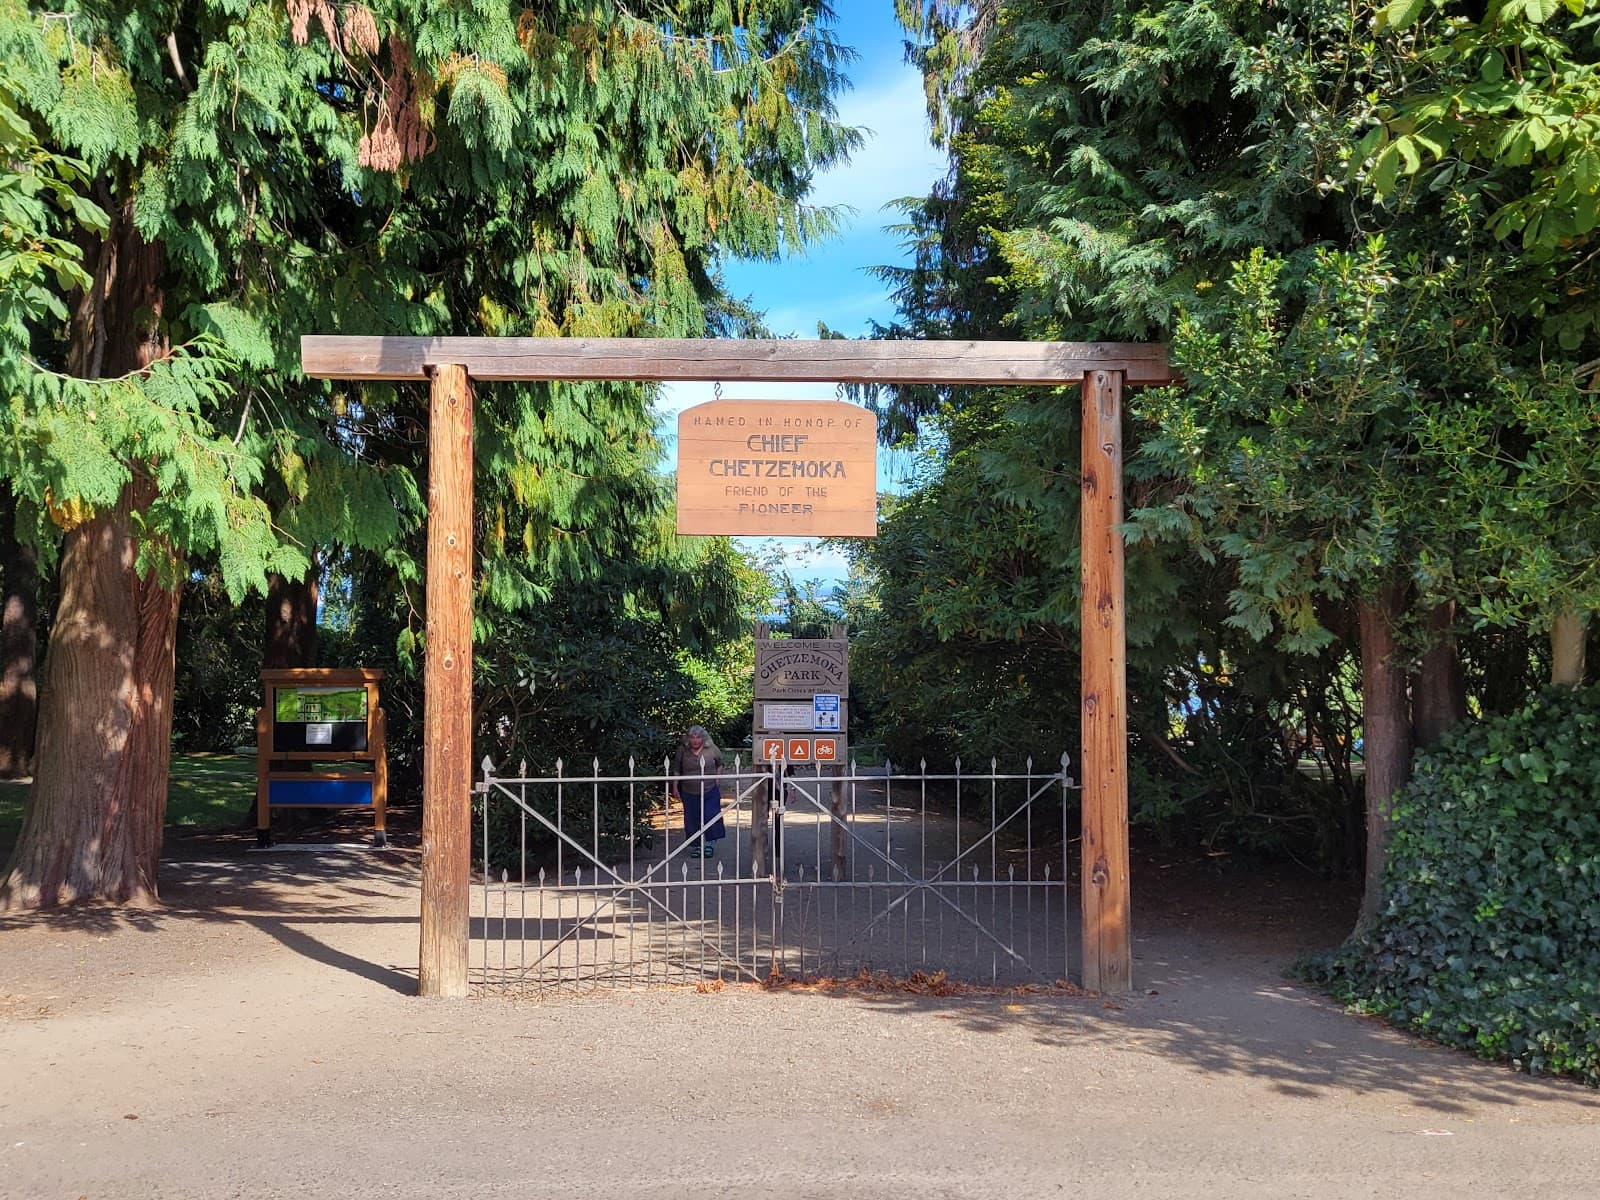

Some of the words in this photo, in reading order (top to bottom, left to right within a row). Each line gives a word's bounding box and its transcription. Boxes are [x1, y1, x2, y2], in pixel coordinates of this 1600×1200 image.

[694, 417, 746, 426] NAMED
[758, 417, 773, 426] IN
[844, 418, 863, 428] OF
[747, 434, 809, 453] CHIEF
[709, 459, 847, 479] CHETZEMOKA
[725, 485, 768, 497] FRIEND
[779, 486, 794, 497] OF
[805, 486, 828, 498] THE
[738, 503, 814, 514] PIONEER
[762, 641, 820, 649] WELCOME
[828, 641, 842, 649] TO
[760, 653, 843, 681] CHETZEMOKA
[784, 670, 821, 680] PARK
